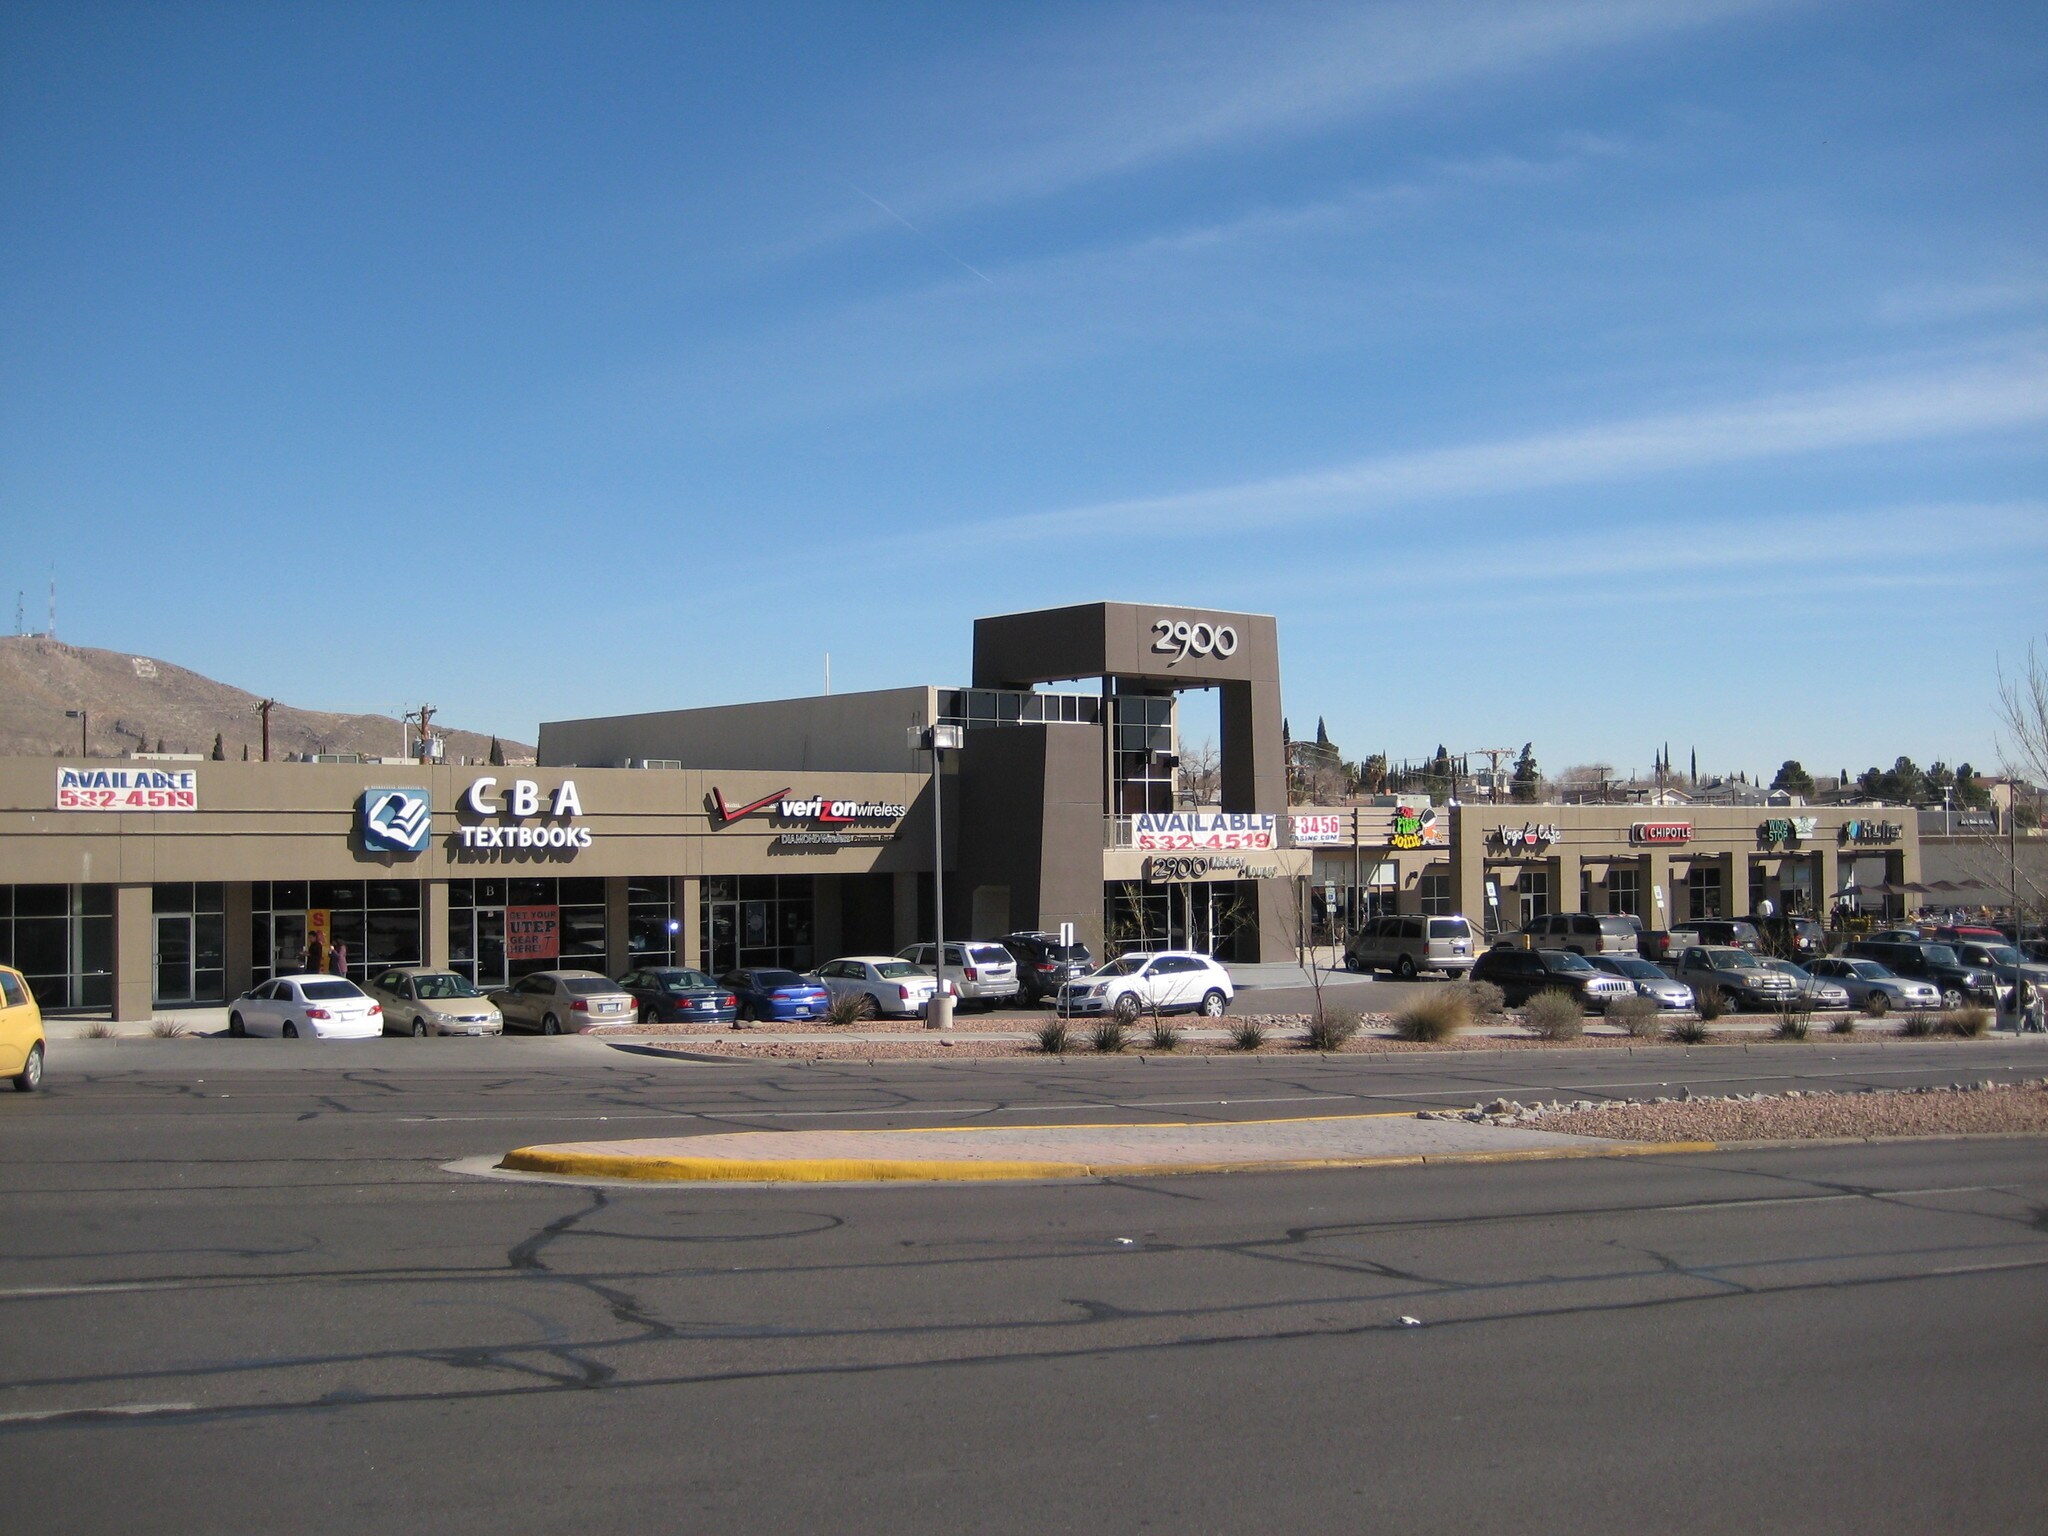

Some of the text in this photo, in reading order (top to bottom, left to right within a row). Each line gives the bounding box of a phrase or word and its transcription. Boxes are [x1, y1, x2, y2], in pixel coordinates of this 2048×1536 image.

[1155, 619, 1238, 664] 2900
[61, 771, 194, 789] AVAILABLE
[60, 790, 194, 807] 532-4519
[1136, 813, 1274, 832] AVAILABLE
[1768, 819, 1788, 831] WING
[461, 826, 593, 848] TEXTBOOKS
[780, 834, 820, 844] DIAMOND
[1538, 823, 1561, 845] Cafe
[1649, 827, 1692, 838] CHIPOTLE
[1768, 830, 1788, 842] STOP
[1138, 833, 1271, 851] 532-4519
[1391, 833, 1421, 849] Joint
[1153, 857, 1209, 883] 2900
[486, 886, 495, 896] B
[509, 911, 557, 919] GET YOUR
[510, 920, 556, 933] UTEP
[510, 935, 539, 945] GEAR
